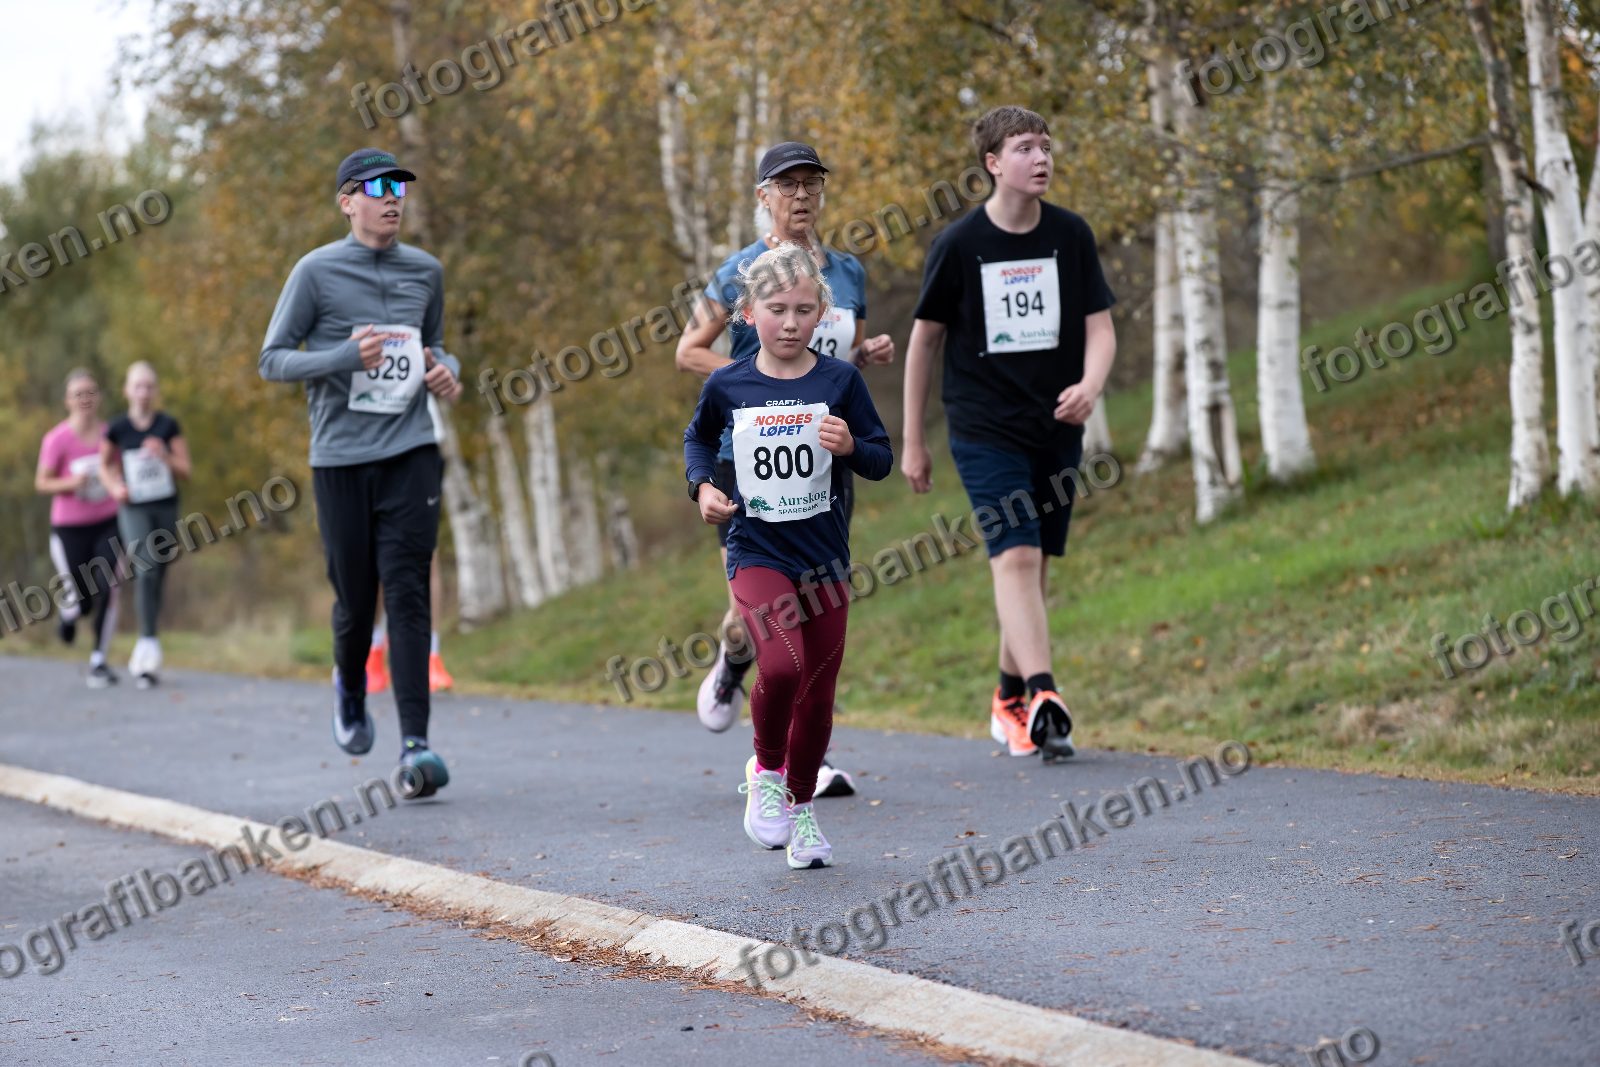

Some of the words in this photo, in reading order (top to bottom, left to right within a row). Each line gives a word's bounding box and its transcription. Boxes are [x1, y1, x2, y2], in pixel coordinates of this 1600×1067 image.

[1001, 290, 1046, 319] 194
[765, 399, 797, 407] CRAFT
[753, 413, 813, 427] NORGES
[759, 425, 804, 437] LØPET
[753, 443, 814, 480] 800
[778, 490, 827, 507] Aurskog
[778, 503, 819, 515] SPAREBANK
